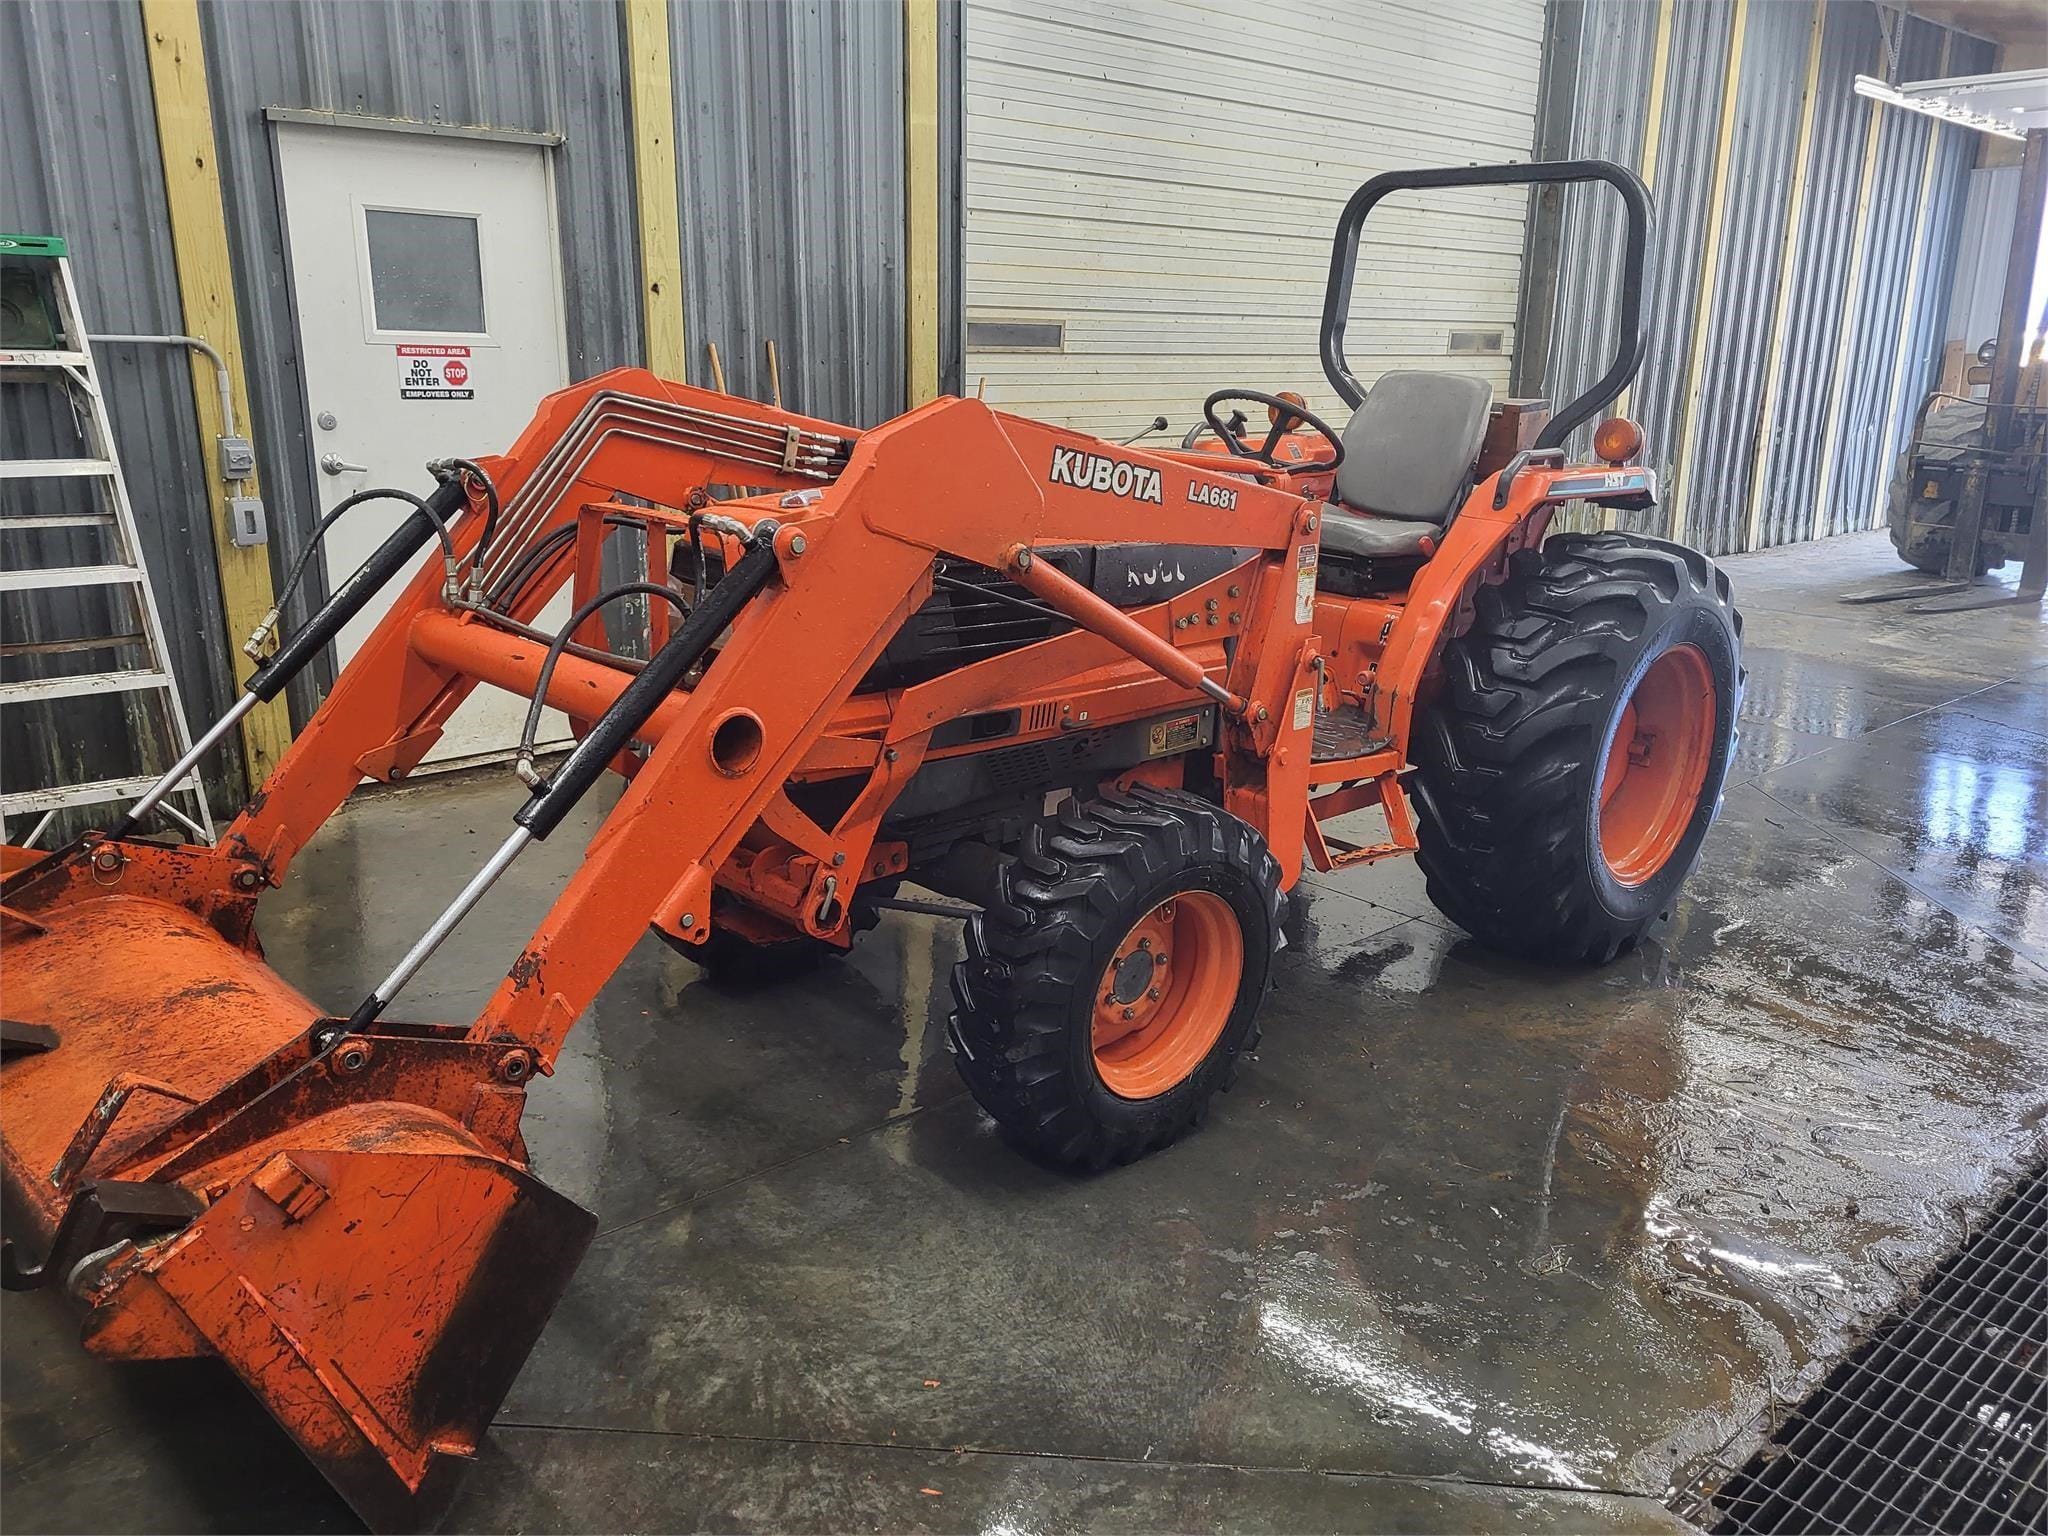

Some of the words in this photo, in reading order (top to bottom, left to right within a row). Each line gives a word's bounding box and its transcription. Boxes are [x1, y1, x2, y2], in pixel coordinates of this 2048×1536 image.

[401, 347, 445, 355] RESTRICTED
[413, 360, 428, 368] DO
[411, 369, 432, 377] NOT
[445, 368, 466, 378] STOP
[405, 378, 440, 386] ENTER
[1050, 446, 1163, 504] KUBOTA
[1604, 473, 1626, 487] HST
[1187, 480, 1238, 511] LA681
